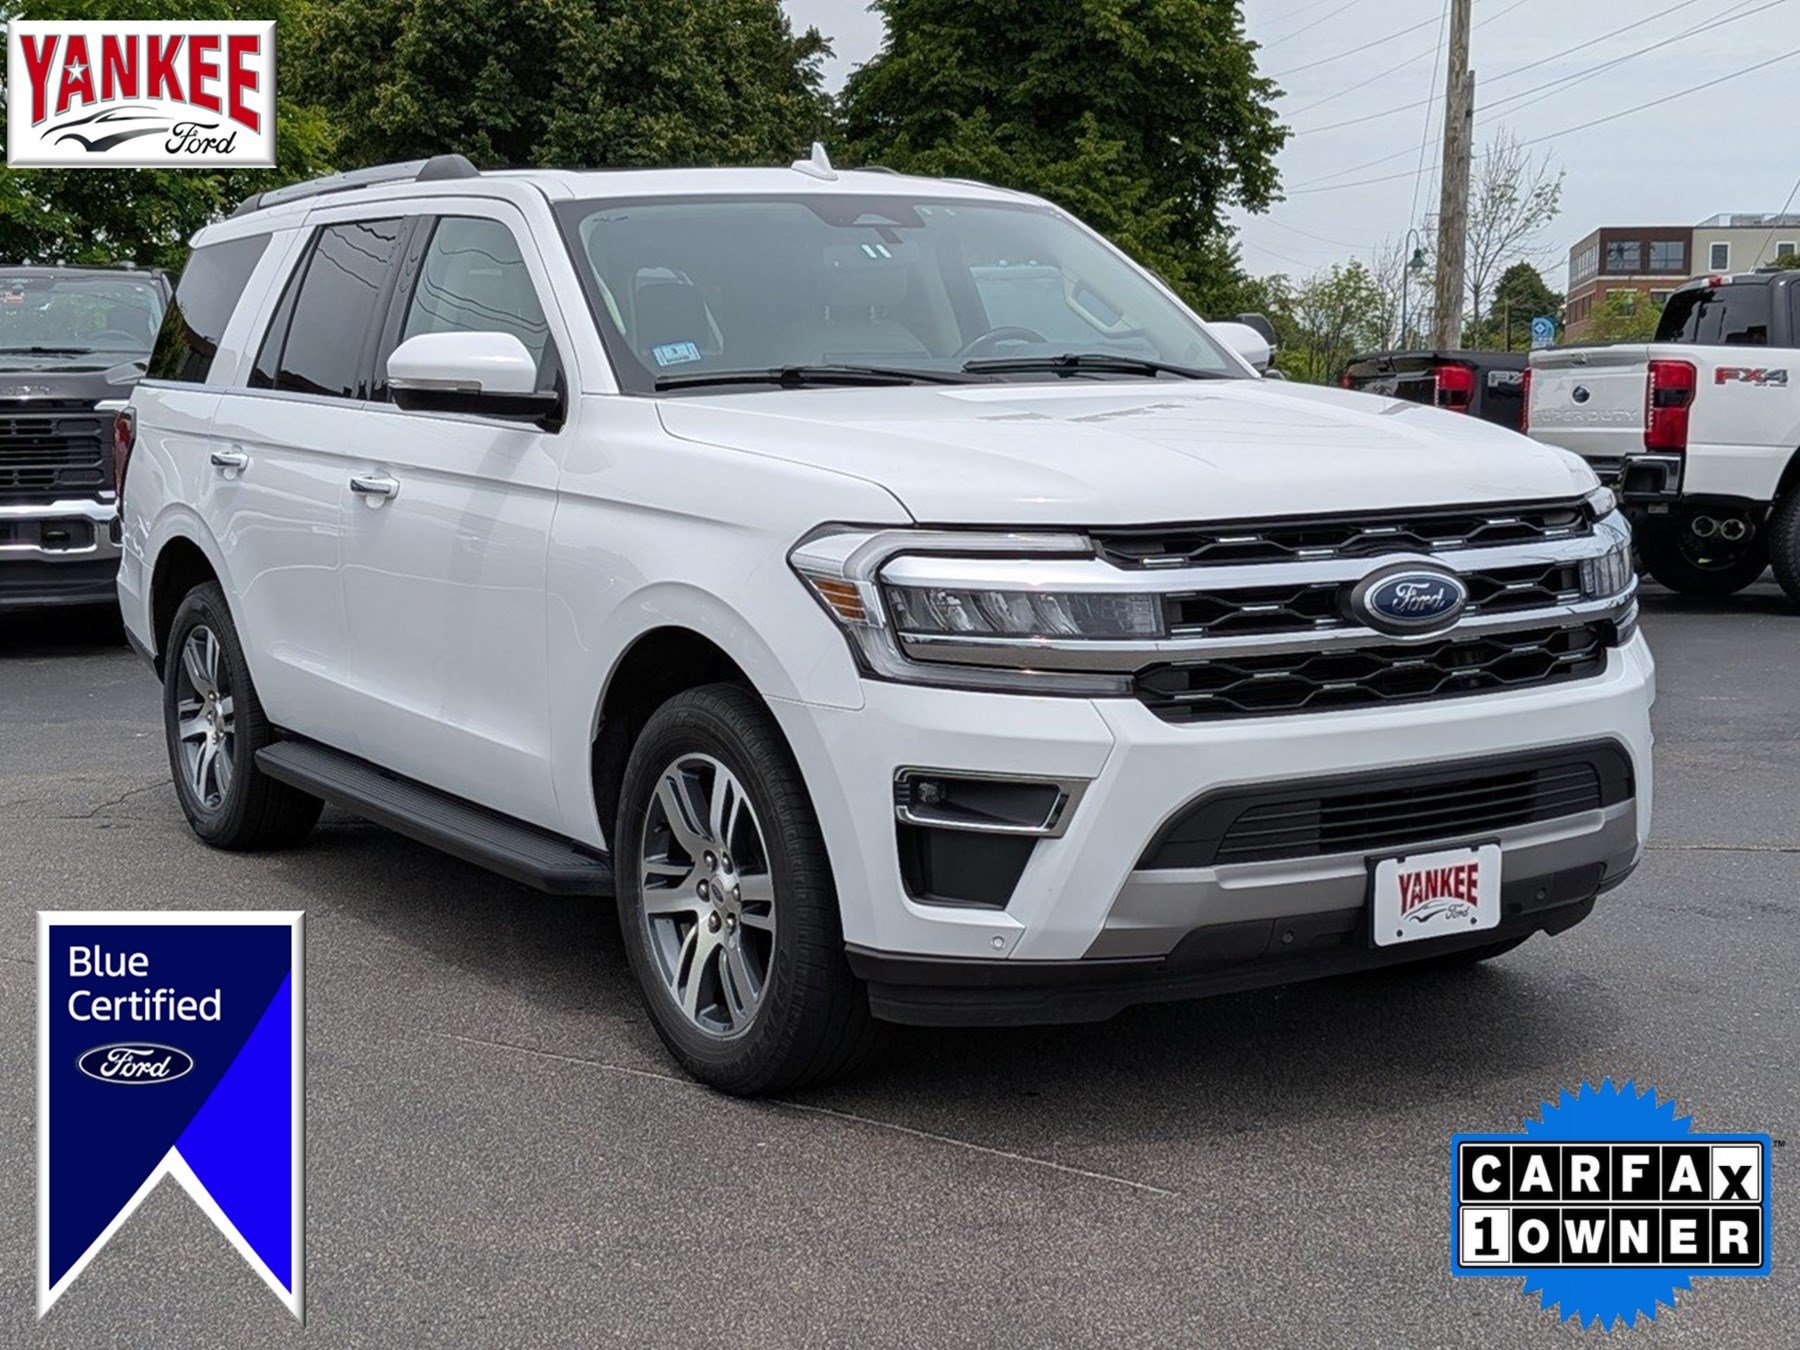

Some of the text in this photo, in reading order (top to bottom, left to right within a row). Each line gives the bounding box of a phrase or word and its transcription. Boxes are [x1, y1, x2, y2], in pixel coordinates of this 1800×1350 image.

[1714, 367, 1788, 385] FX4
[1393, 582, 1444, 612] Ford
[1398, 862, 1479, 917] YANKEE
[1445, 903, 1470, 920] Ford
